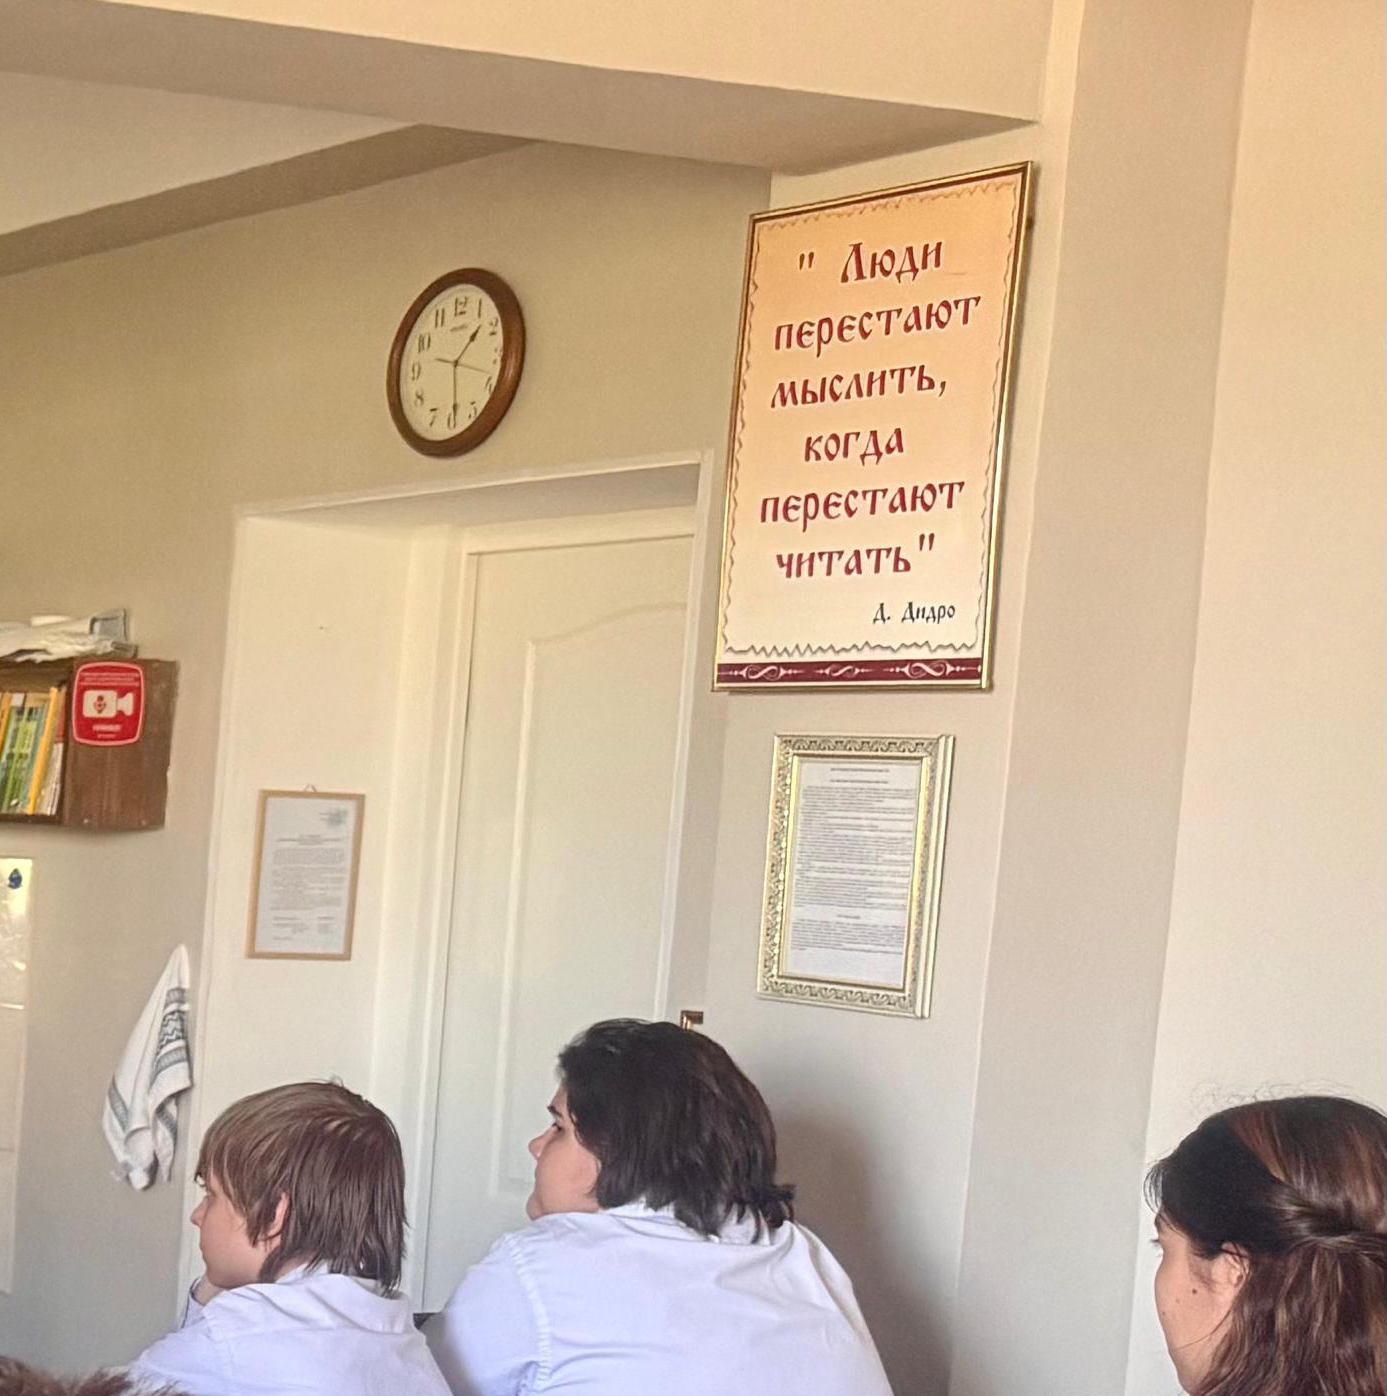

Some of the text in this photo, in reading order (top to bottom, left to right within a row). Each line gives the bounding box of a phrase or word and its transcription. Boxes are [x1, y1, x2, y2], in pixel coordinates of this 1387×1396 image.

[840, 240, 944, 284] Люди
[434, 307, 446, 328] 11
[454, 295, 470, 317] 12
[417, 332, 432, 353] 10
[489, 317, 498, 336] 2
[773, 295, 982, 358] перестают
[770, 364, 947, 409] мыслить,
[429, 407, 439, 428] 7
[803, 427, 904, 466] когда
[759, 480, 965, 533] перестают
[775, 533, 935, 579] читать"
[872, 601, 957, 626] Д. Дидро
